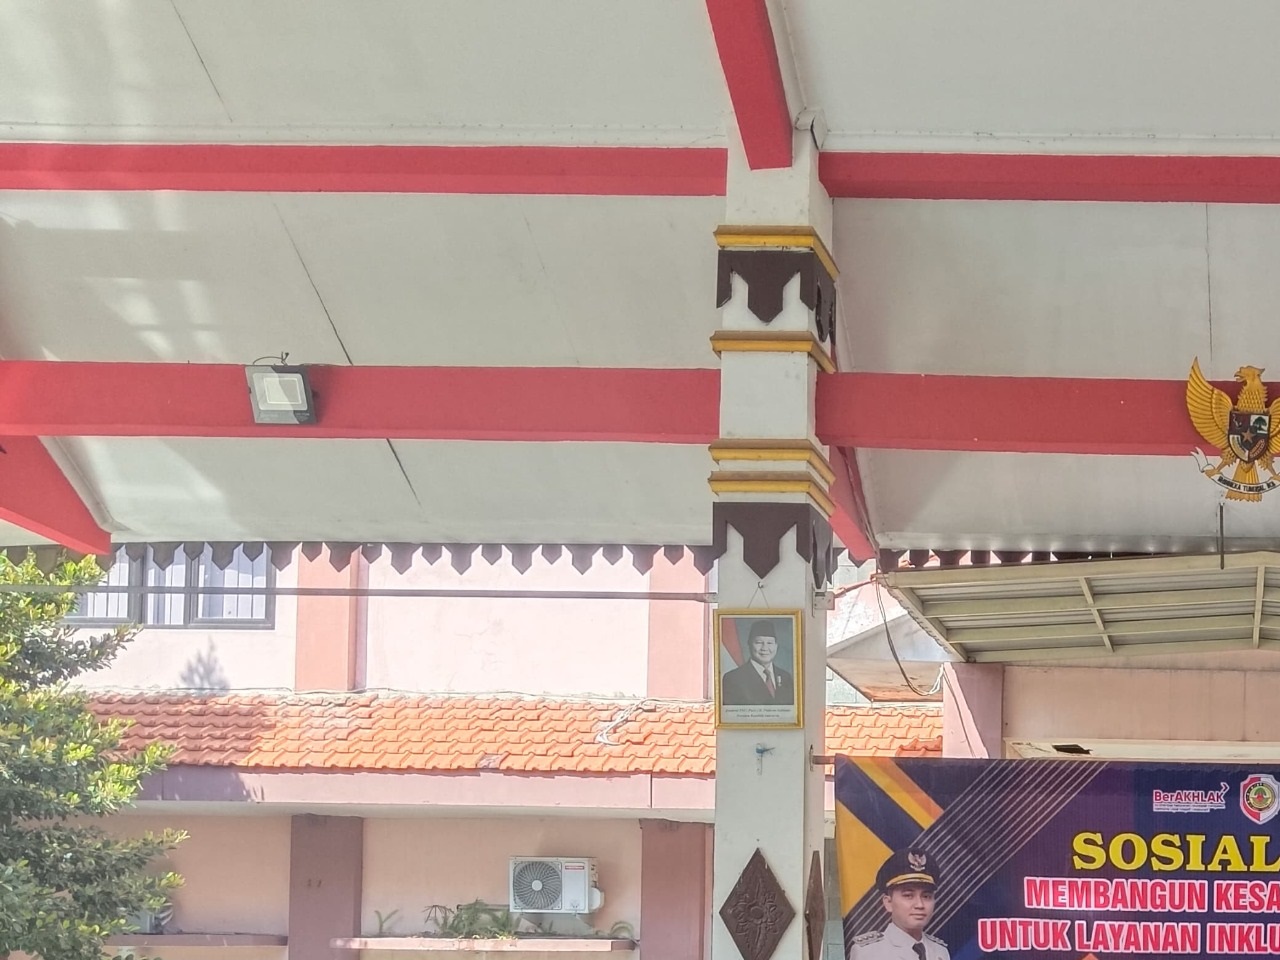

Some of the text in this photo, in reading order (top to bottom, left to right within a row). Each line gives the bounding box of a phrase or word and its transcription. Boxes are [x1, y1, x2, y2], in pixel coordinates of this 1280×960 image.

[1154, 790, 1224, 803] BerAKHLAK
[1025, 878, 1208, 911] MEMBANGUN
[978, 919, 1071, 952] UNTUK
[1075, 921, 1201, 953] LAYANAN
